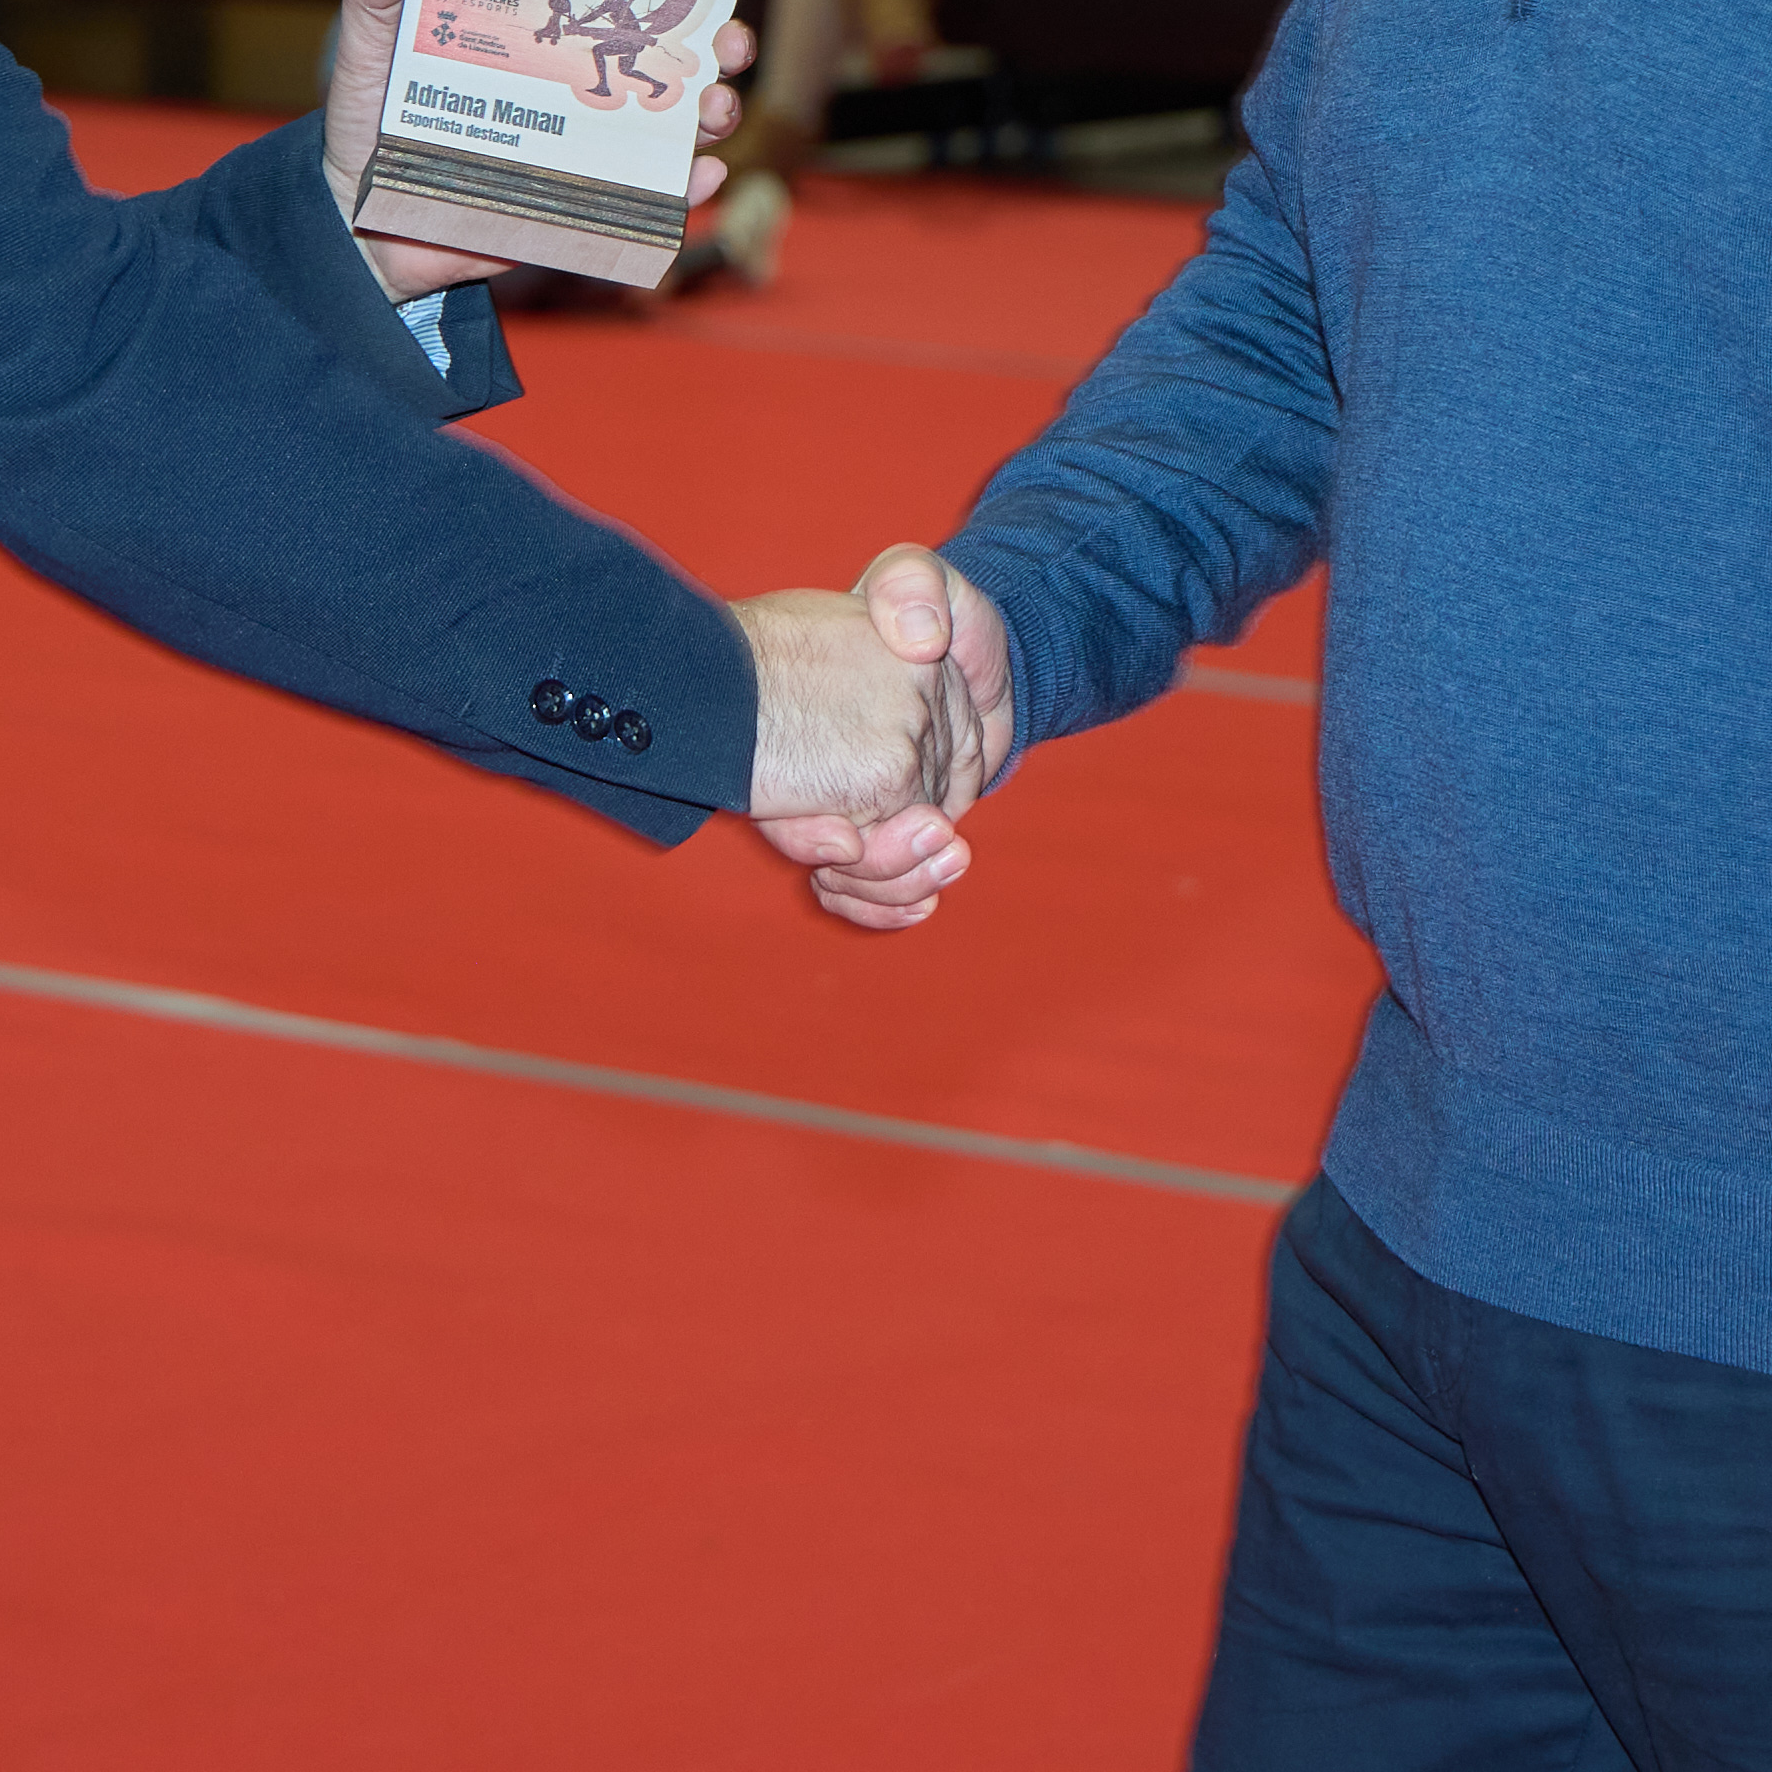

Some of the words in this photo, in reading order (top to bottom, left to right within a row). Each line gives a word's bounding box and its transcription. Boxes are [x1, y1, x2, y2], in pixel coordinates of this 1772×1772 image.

[400, 109, 462, 135] Esportista
[465, 124, 521, 147] destacat
[403, 80, 487, 119] Adriana
[491, 98, 566, 136] Manau
